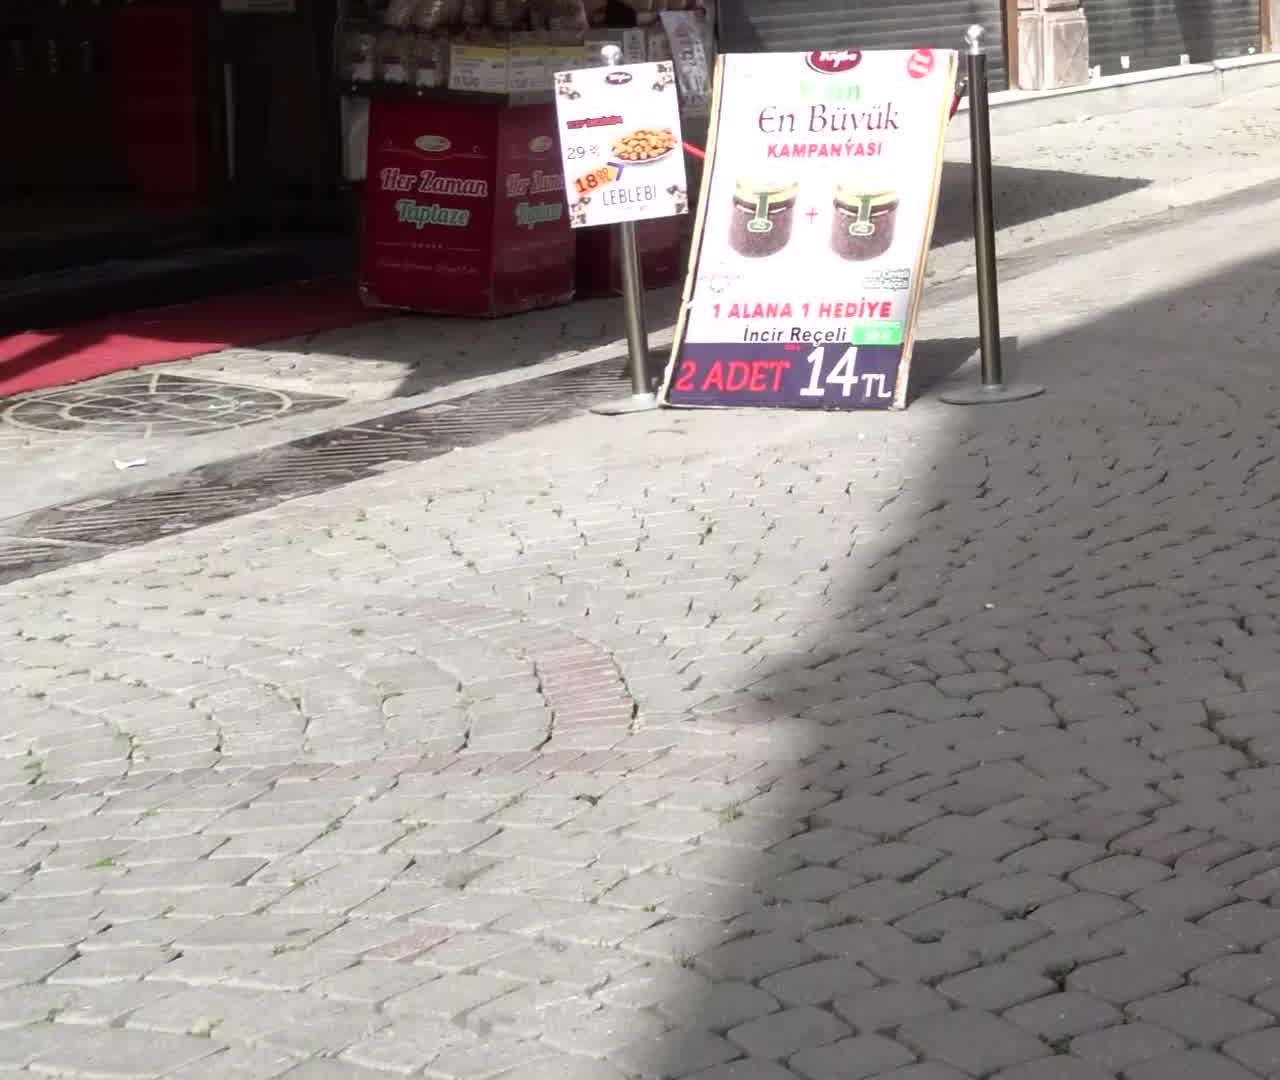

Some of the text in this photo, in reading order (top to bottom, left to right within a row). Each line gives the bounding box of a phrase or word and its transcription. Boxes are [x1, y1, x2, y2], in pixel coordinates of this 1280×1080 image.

[758, 104, 795, 133] En
[767, 141, 882, 158] KAMPANYASI
[380, 167, 489, 198] Her Zaman
[712, 296, 893, 318] 1 ALANA 1 HEDİYE
[743, 324, 783, 342] İncir
[789, 327, 847, 346] Reçeli
[674, 346, 892, 398] 2 ADET 14 TL
